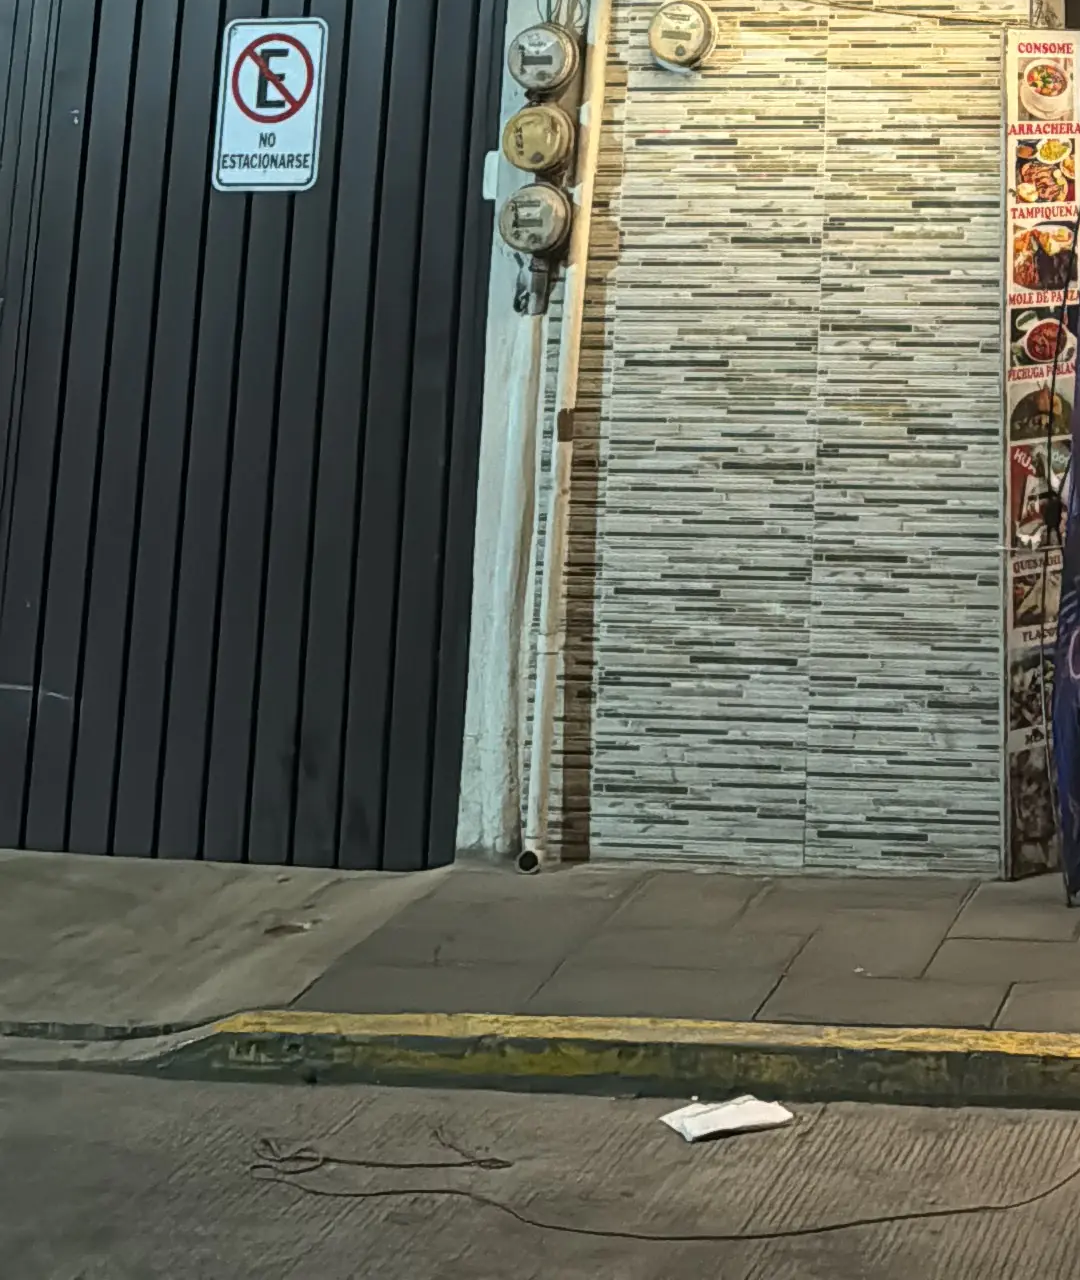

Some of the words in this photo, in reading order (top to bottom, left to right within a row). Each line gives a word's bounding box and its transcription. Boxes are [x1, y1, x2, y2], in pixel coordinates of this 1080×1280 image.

[1017, 42, 1074, 55] CONSOME
[258, 131, 277, 149] NO
[221, 152, 311, 170] ESTACIONARSE
[1010, 201, 1080, 220] TAMPIQUEÑA
[1008, 292, 1034, 305] MOLE
